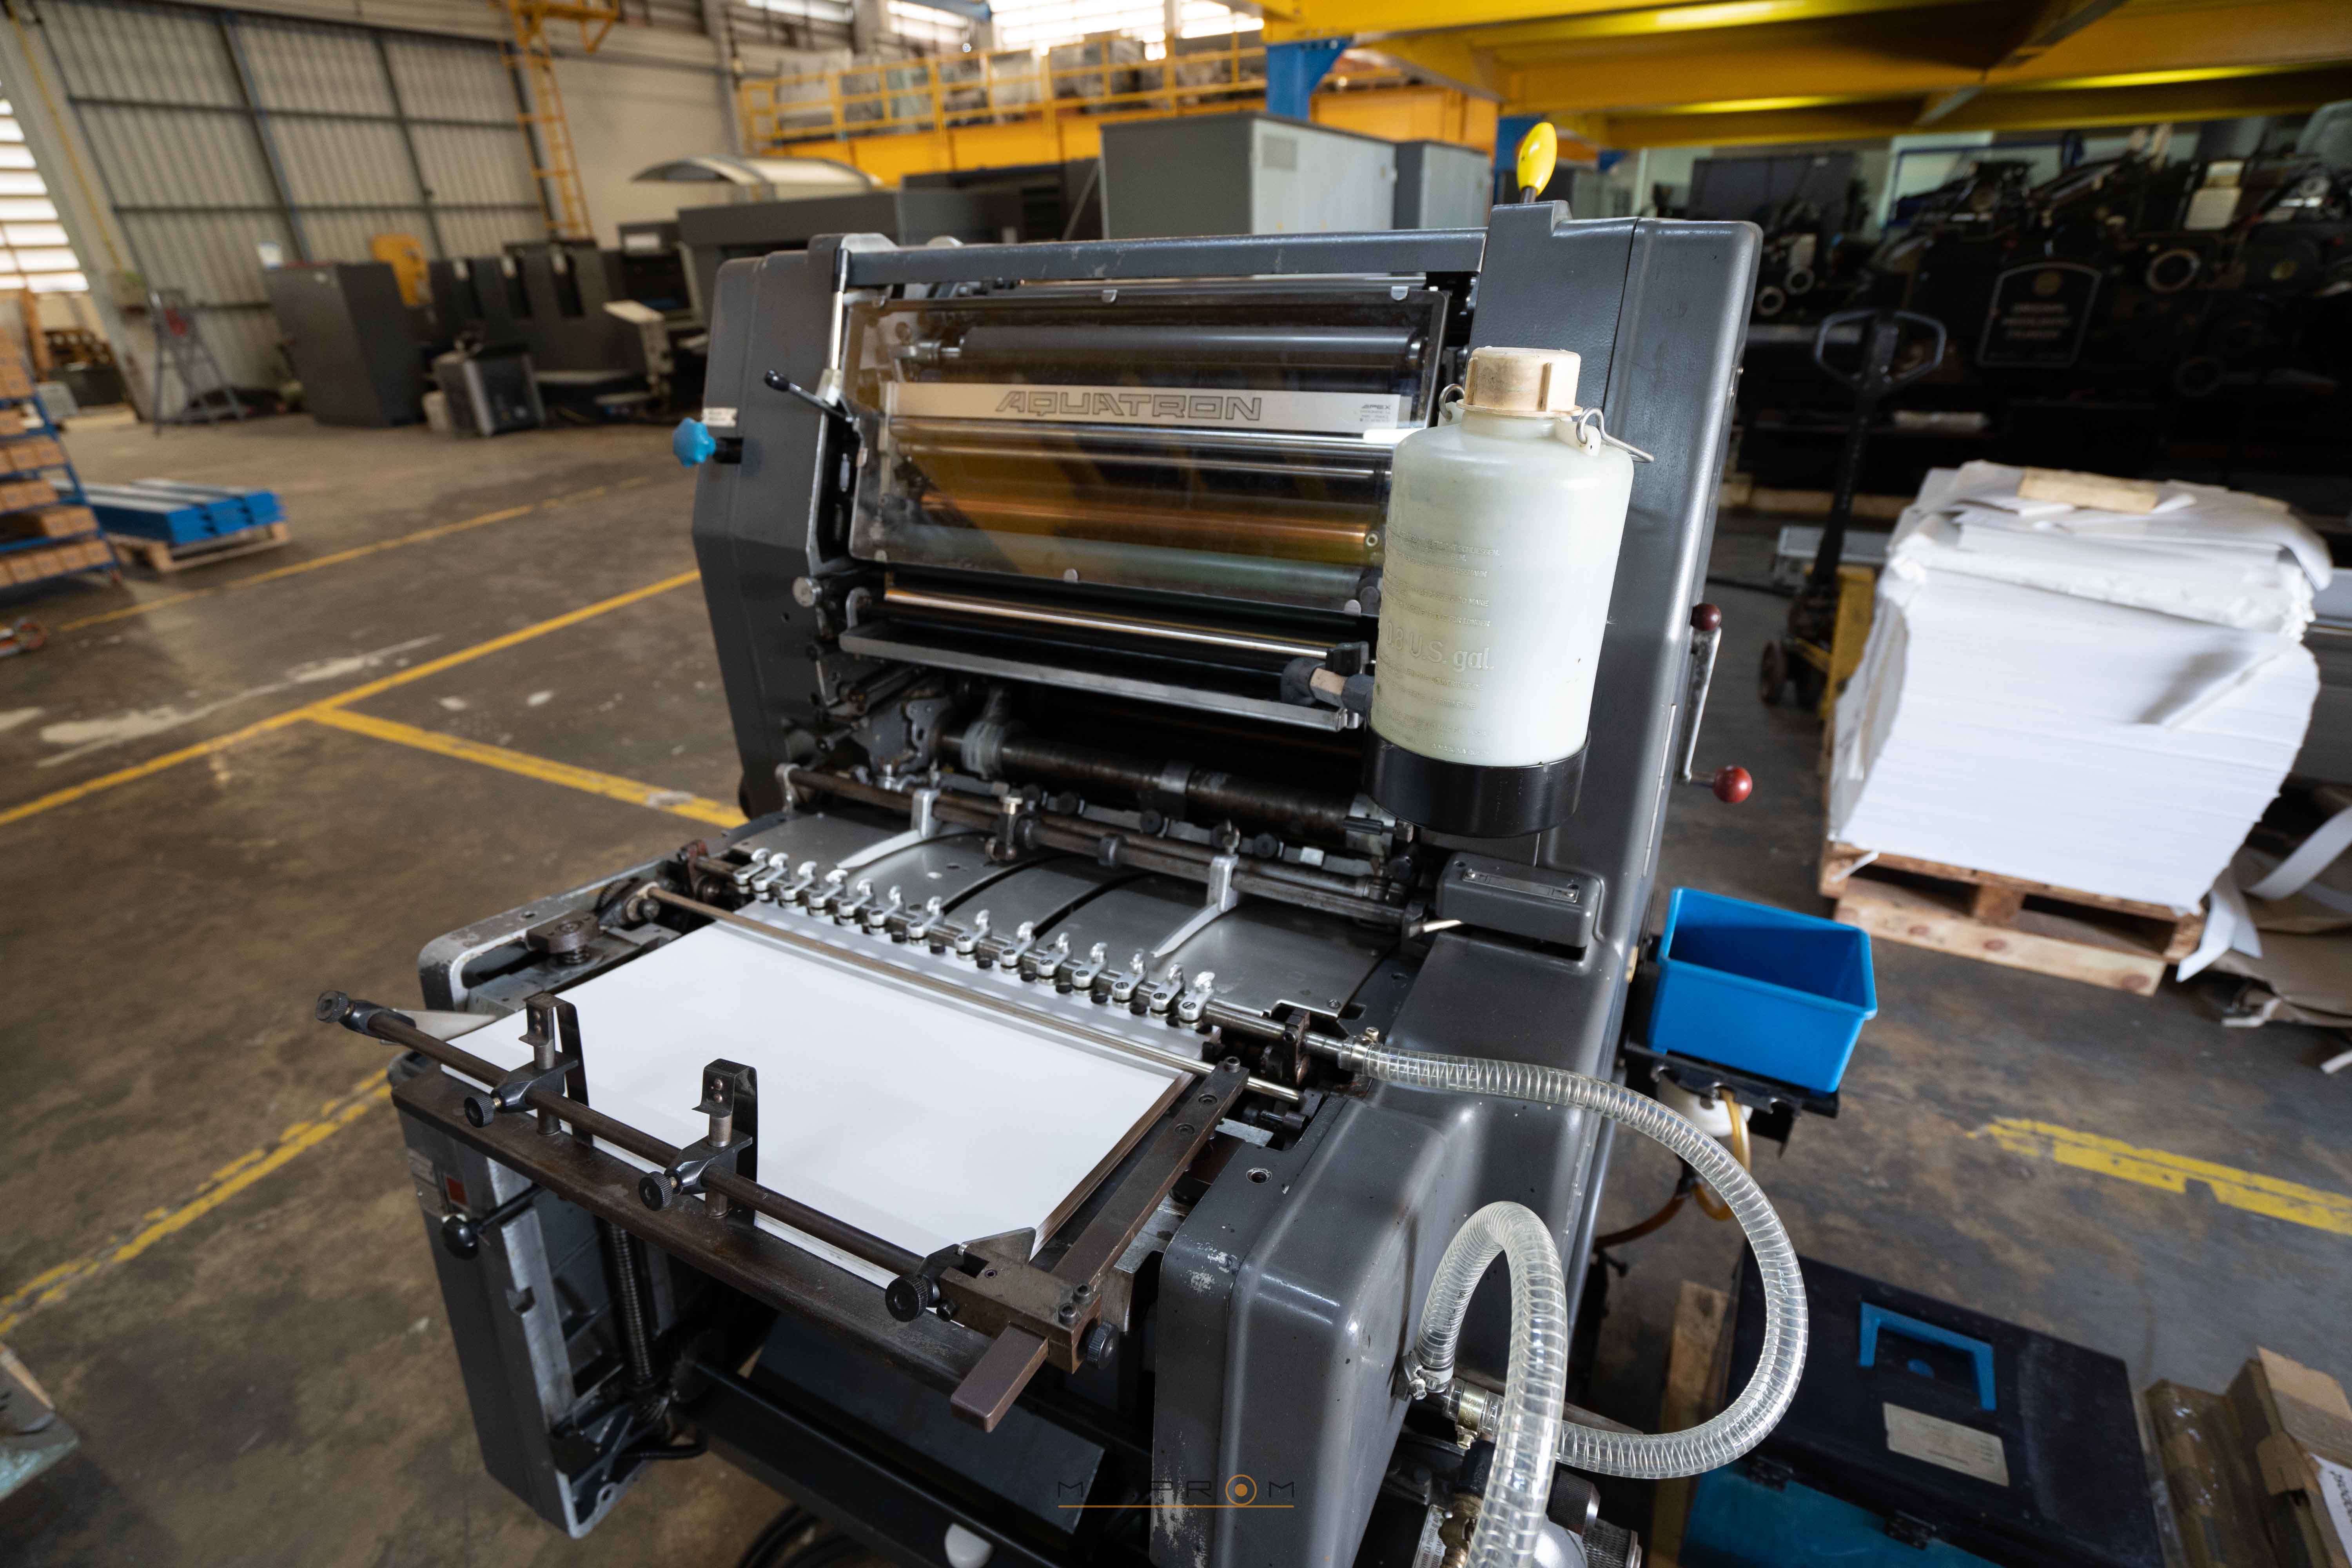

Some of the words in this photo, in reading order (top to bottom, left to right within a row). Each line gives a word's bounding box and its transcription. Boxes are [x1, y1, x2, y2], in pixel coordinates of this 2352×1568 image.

[995, 391, 1261, 421] AQUATRON
[1450, 615, 1462, 624] FOR
[1409, 630, 1447, 664] U.S.
[1453, 647, 1494, 673] gal.
[1427, 1528, 1436, 1544] PURGE
